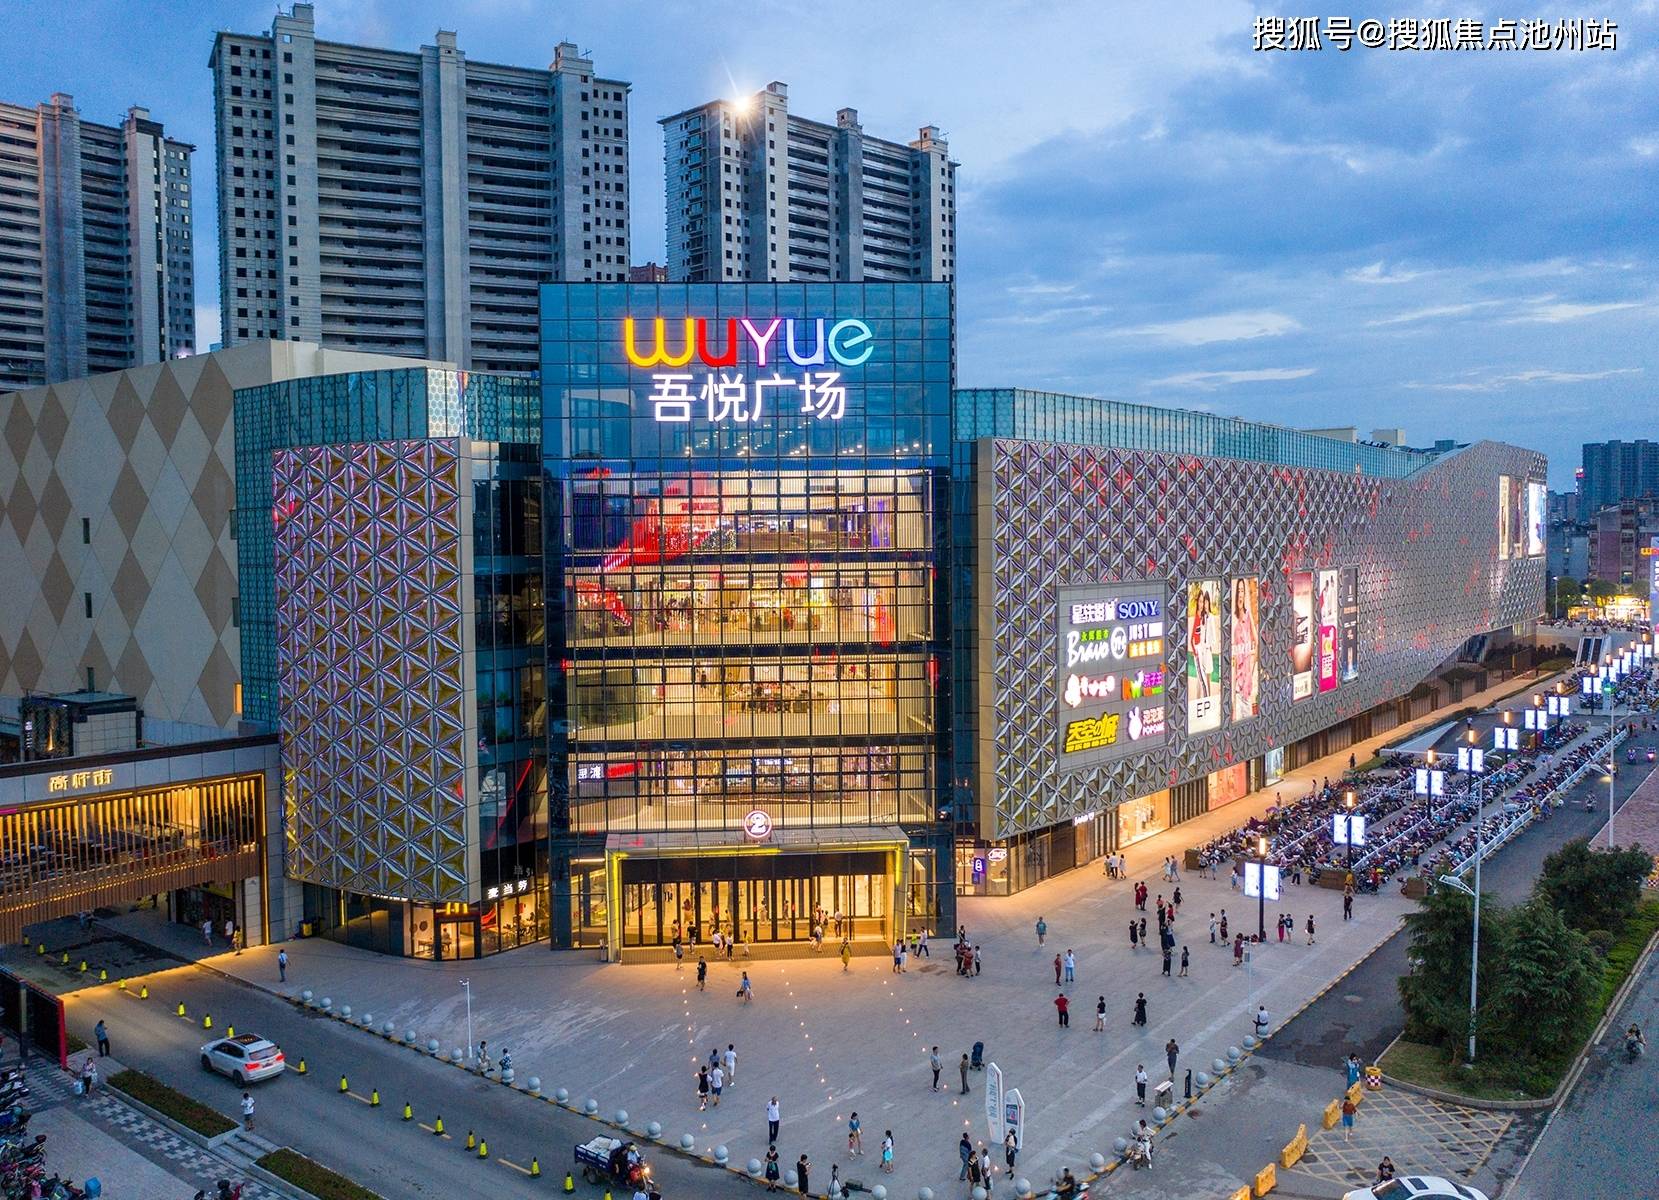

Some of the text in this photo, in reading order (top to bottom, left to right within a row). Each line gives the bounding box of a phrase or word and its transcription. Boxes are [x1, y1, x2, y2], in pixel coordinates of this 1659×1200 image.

[648, 372, 846, 422] 吾悦广场
[1119, 600, 1158, 619] SONY
[1066, 630, 1109, 667] Bravo
[1196, 701, 1211, 718] EP
[487, 879, 528, 899] 麦当劳
